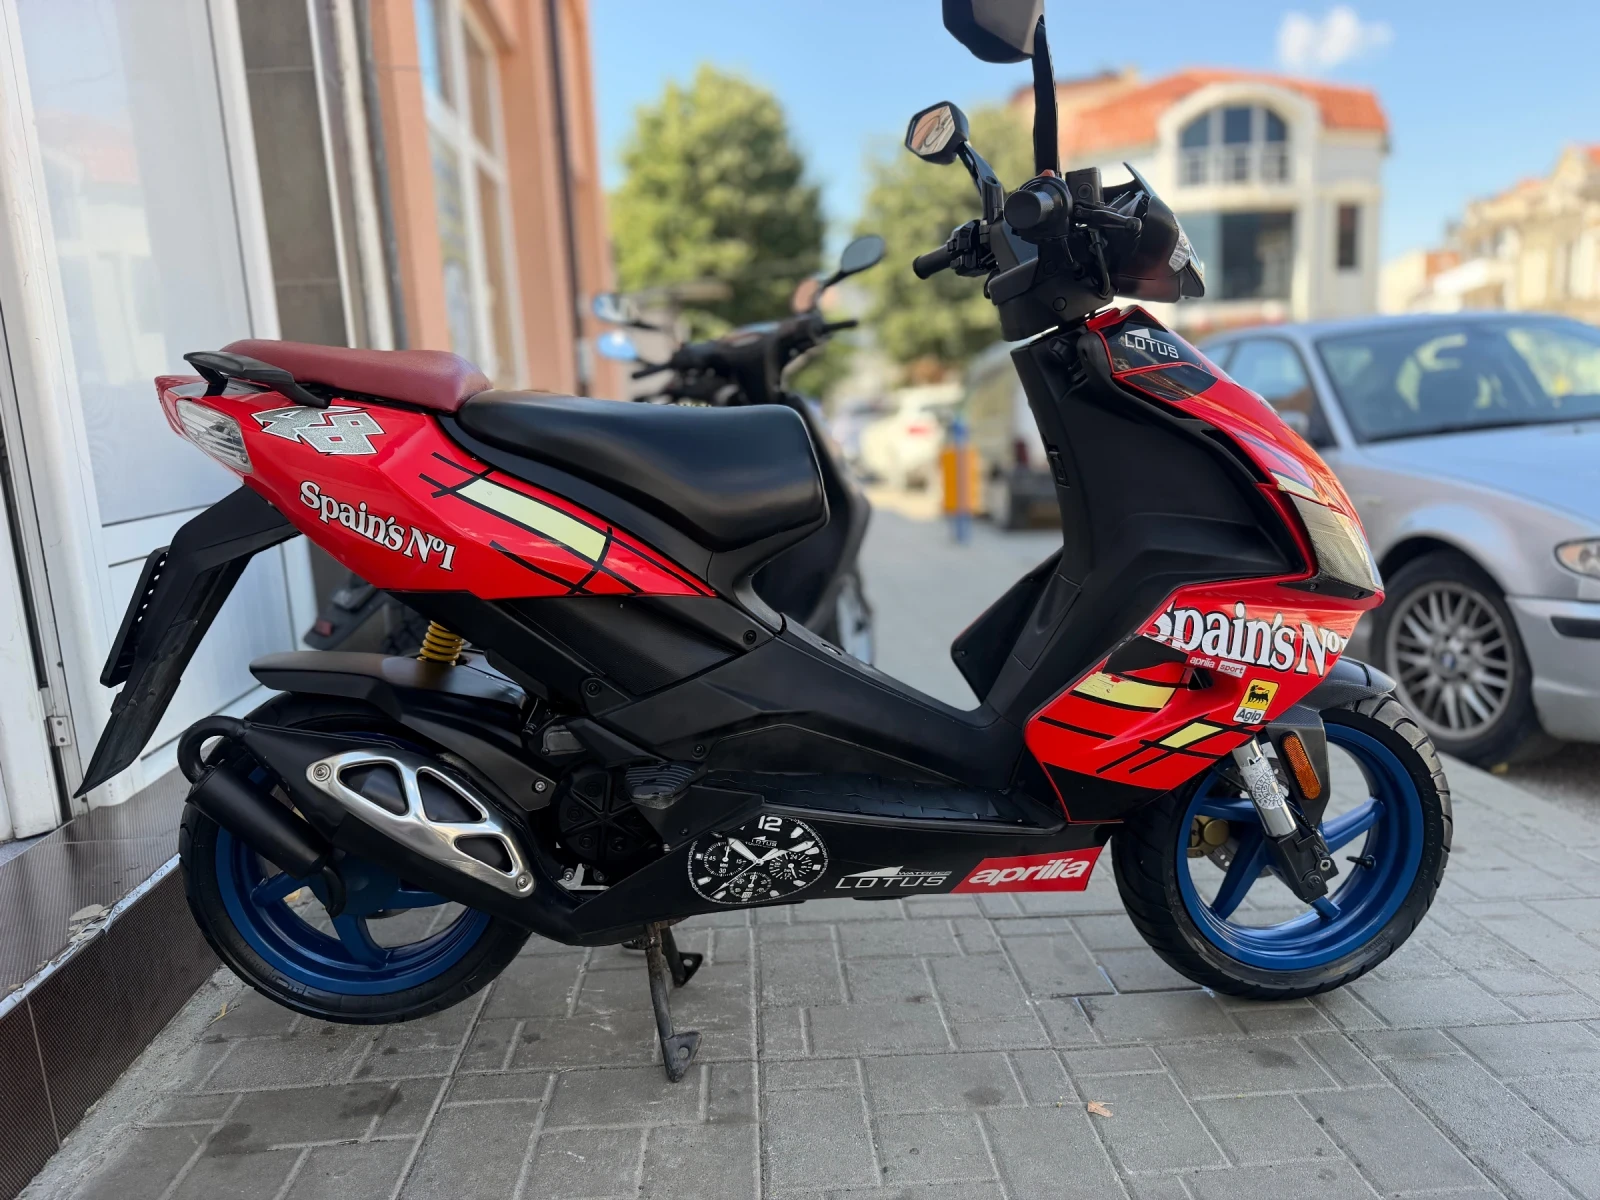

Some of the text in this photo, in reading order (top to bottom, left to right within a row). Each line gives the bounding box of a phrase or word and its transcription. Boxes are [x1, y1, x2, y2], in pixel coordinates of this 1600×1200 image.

[1125, 334, 1179, 359] LOTUS
[300, 481, 404, 551] Spain's
[1189, 656, 1244, 675] aprilia sport
[1236, 708, 1262, 722] Agip
[757, 815, 782, 832] 12
[897, 869, 953, 877] WATCHES
[968, 858, 1090, 886] aprilia
[835, 875, 948, 889] LOTUS
